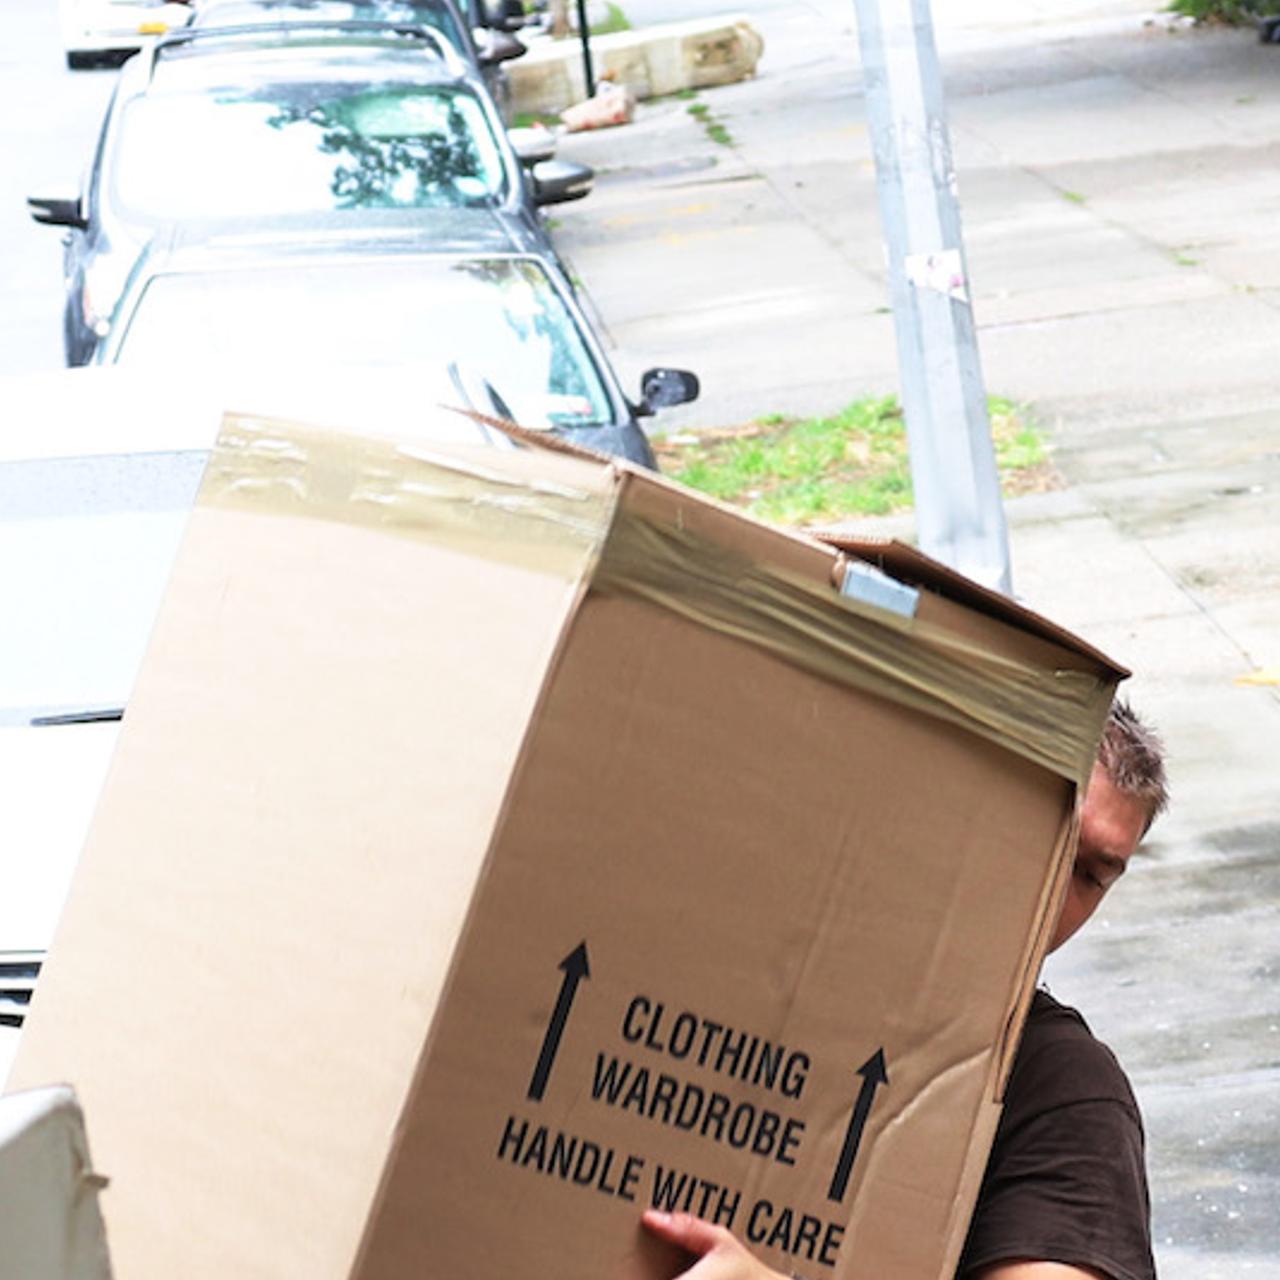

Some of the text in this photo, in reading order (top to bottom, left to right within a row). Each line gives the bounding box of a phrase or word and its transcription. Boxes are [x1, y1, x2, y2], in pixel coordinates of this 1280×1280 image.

[622, 995, 810, 1100] CLOTHING
[591, 1052, 806, 1166] WARDROBE
[497, 1115, 846, 1267] HANDLE WITH CARE
